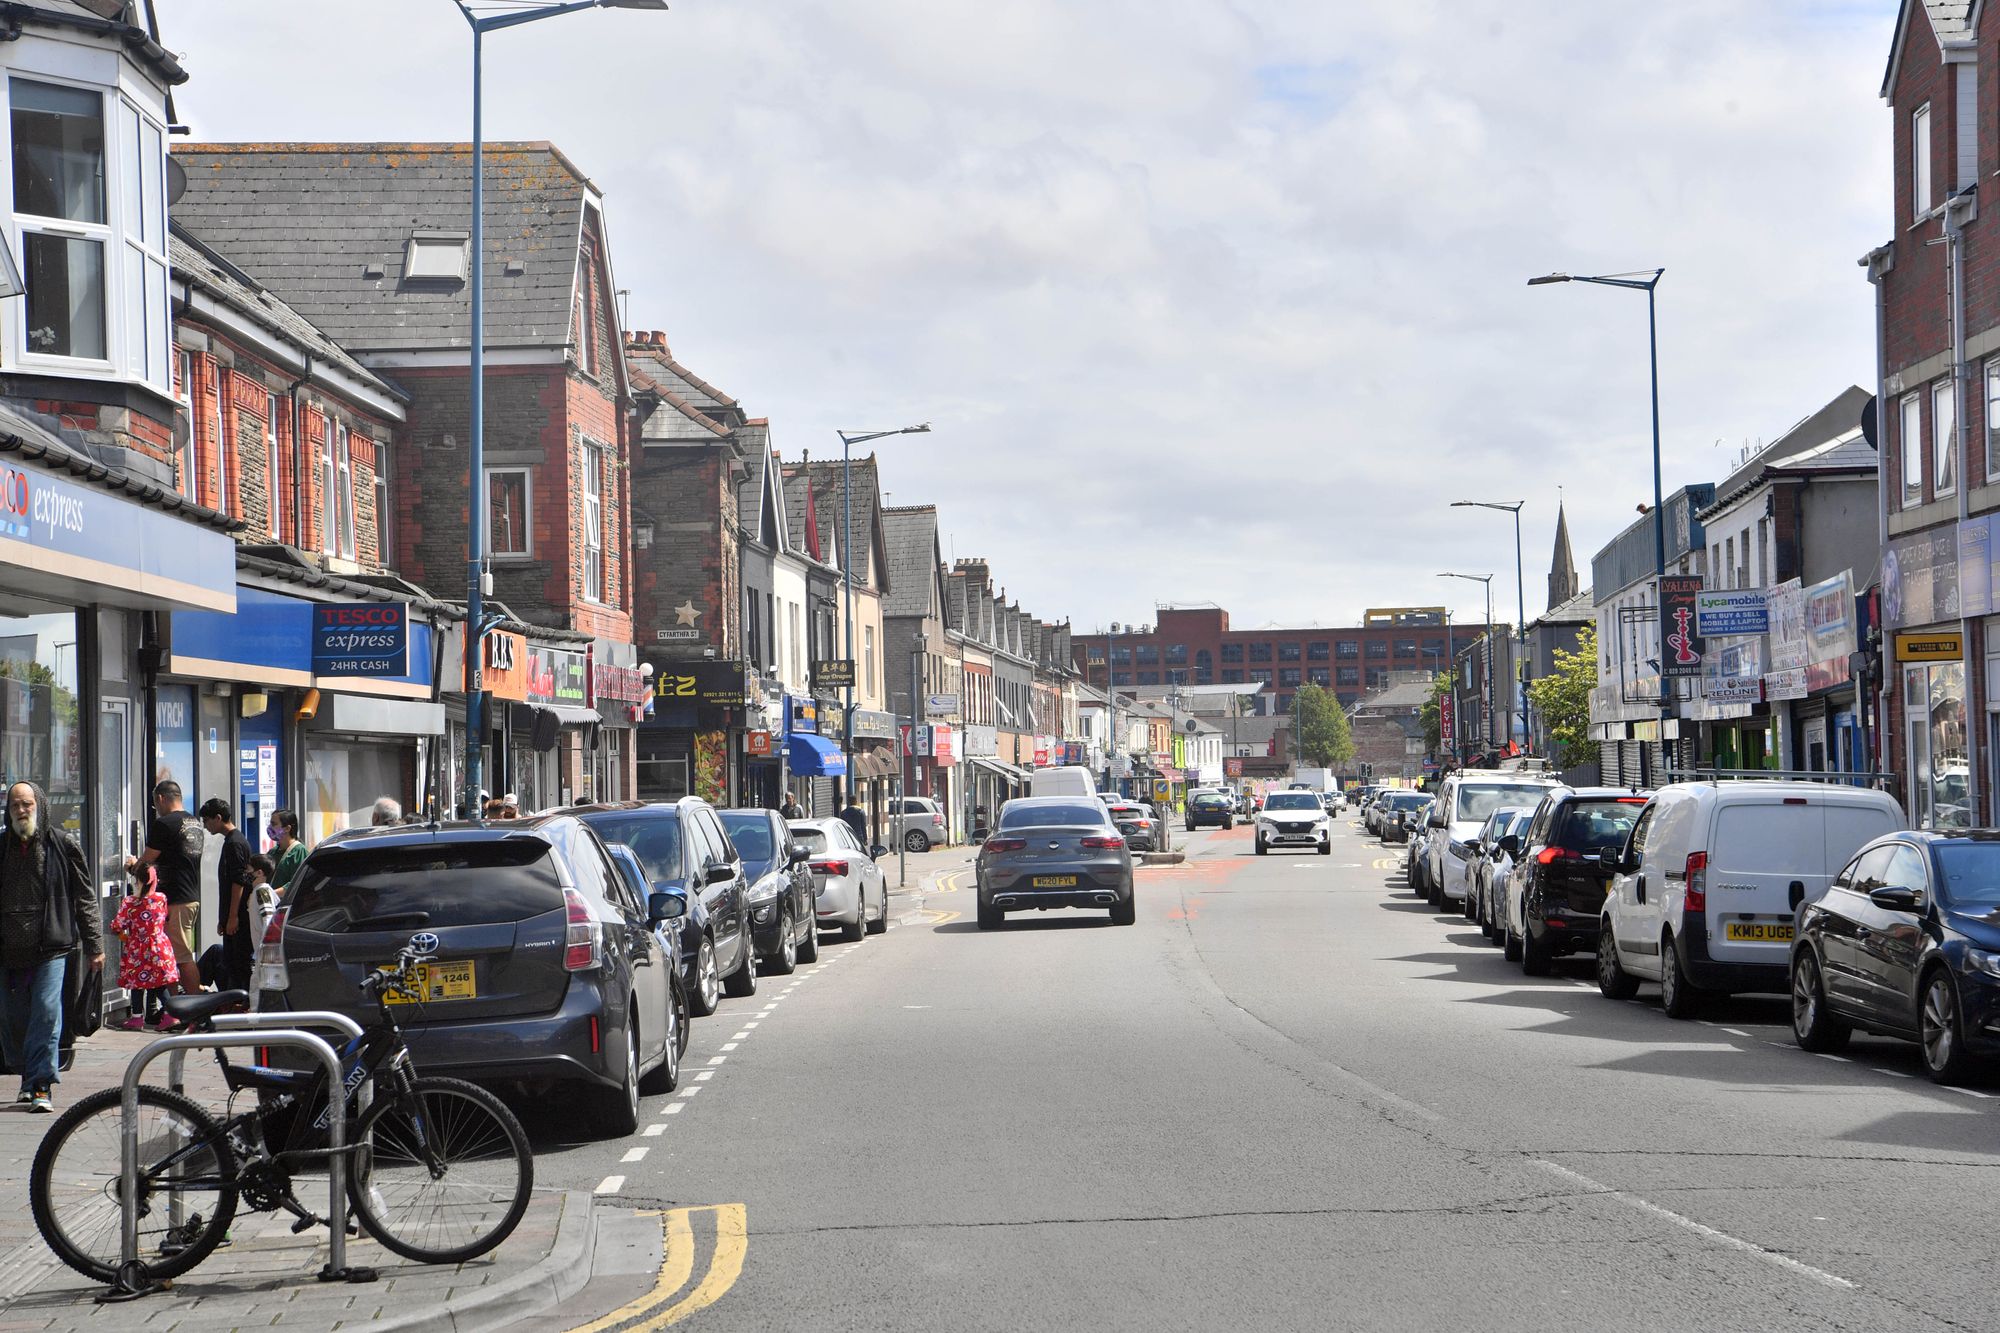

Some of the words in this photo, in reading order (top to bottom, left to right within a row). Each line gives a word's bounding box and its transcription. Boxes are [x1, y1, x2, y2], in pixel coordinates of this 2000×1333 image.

[34, 485, 83, 540] express
[1701, 594, 1766, 608] Lycamobile
[320, 608, 399, 625] TESCO
[325, 633, 395, 652] express
[330, 661, 358, 670] 24HR
[360, 661, 390, 670] CASH
[831, 673, 852, 681] Dragon
[1708, 688, 1758, 697] REDLINE
[1733, 925, 1764, 938] KM13
[1767, 926, 1795, 938] UGE
[442, 974, 470, 982] 1246
